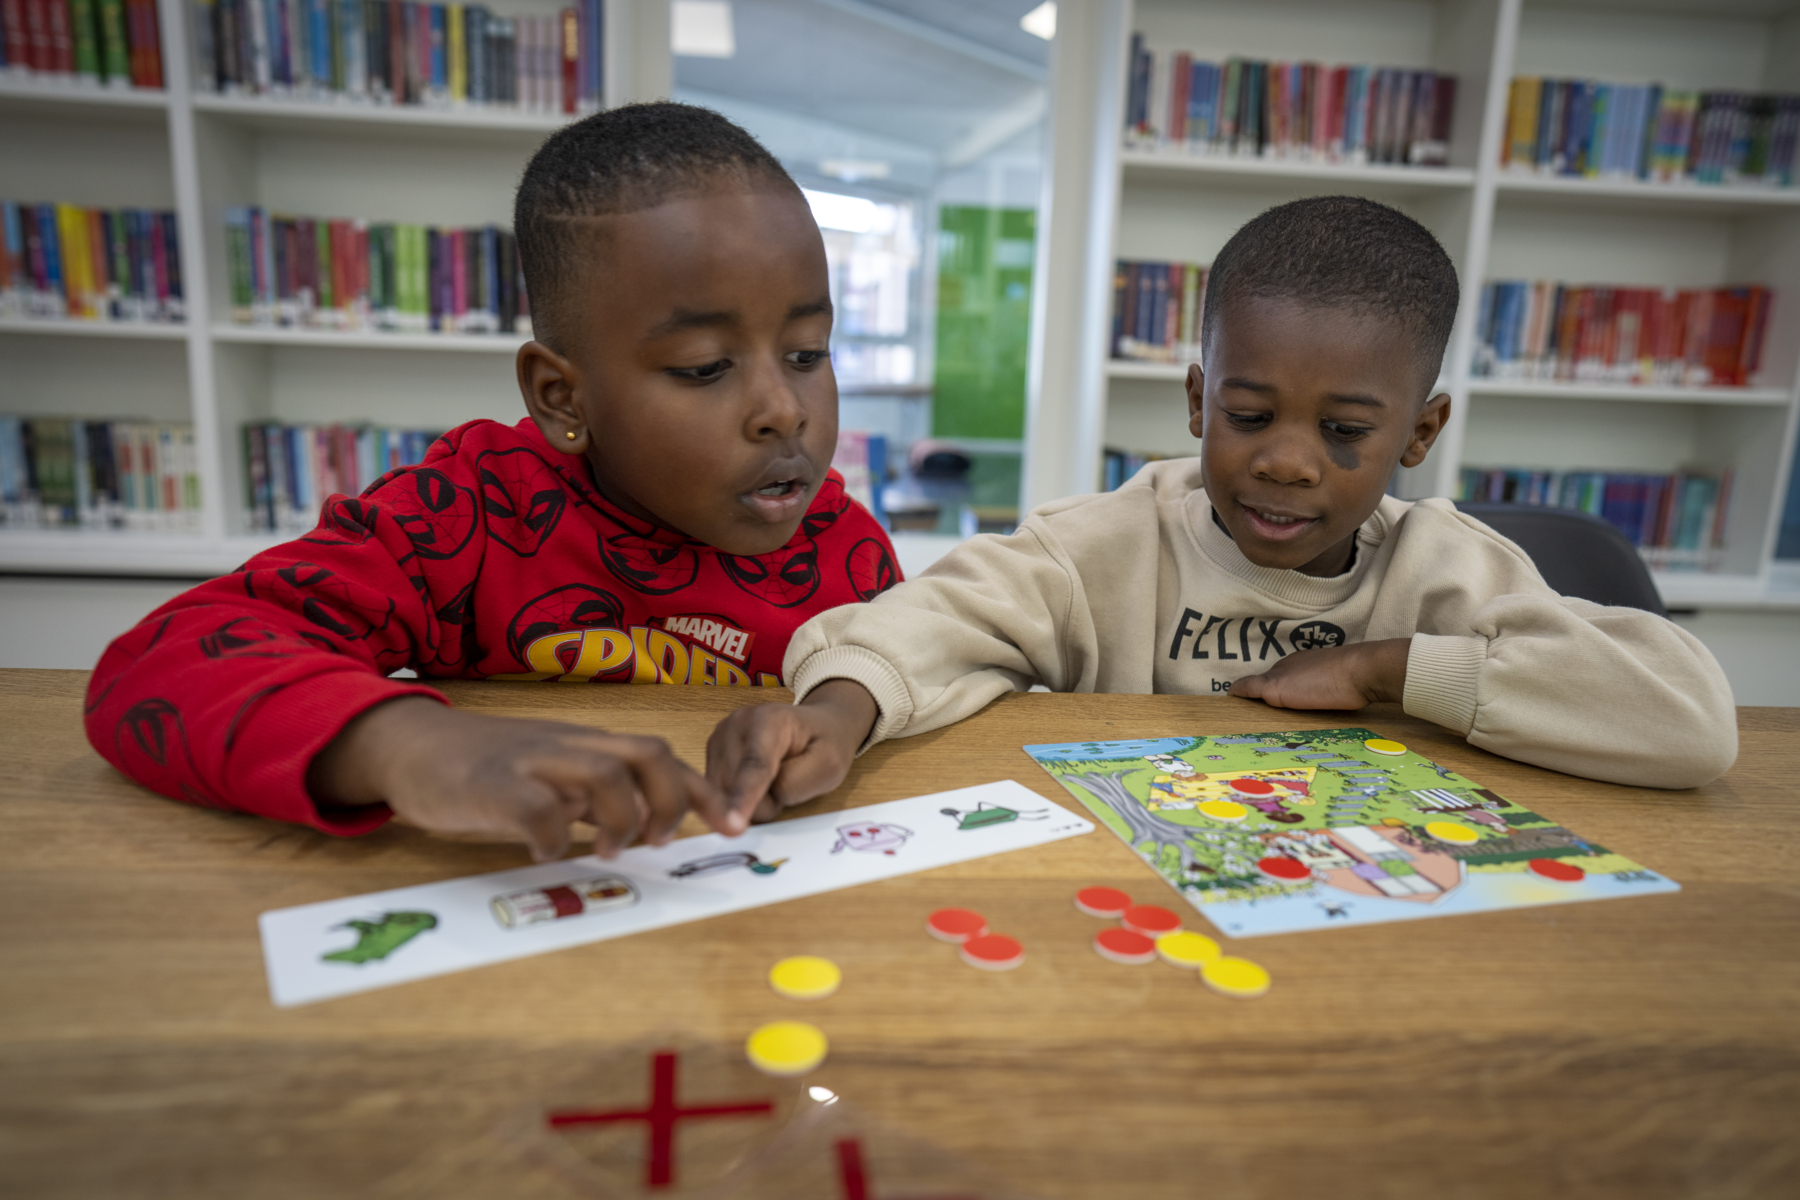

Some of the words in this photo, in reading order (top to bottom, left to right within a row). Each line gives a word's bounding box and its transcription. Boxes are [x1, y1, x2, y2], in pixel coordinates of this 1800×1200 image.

[664, 616, 749, 661] MARVEL
[1168, 607, 1287, 662] FELIX
[1299, 625, 1339, 643] The
